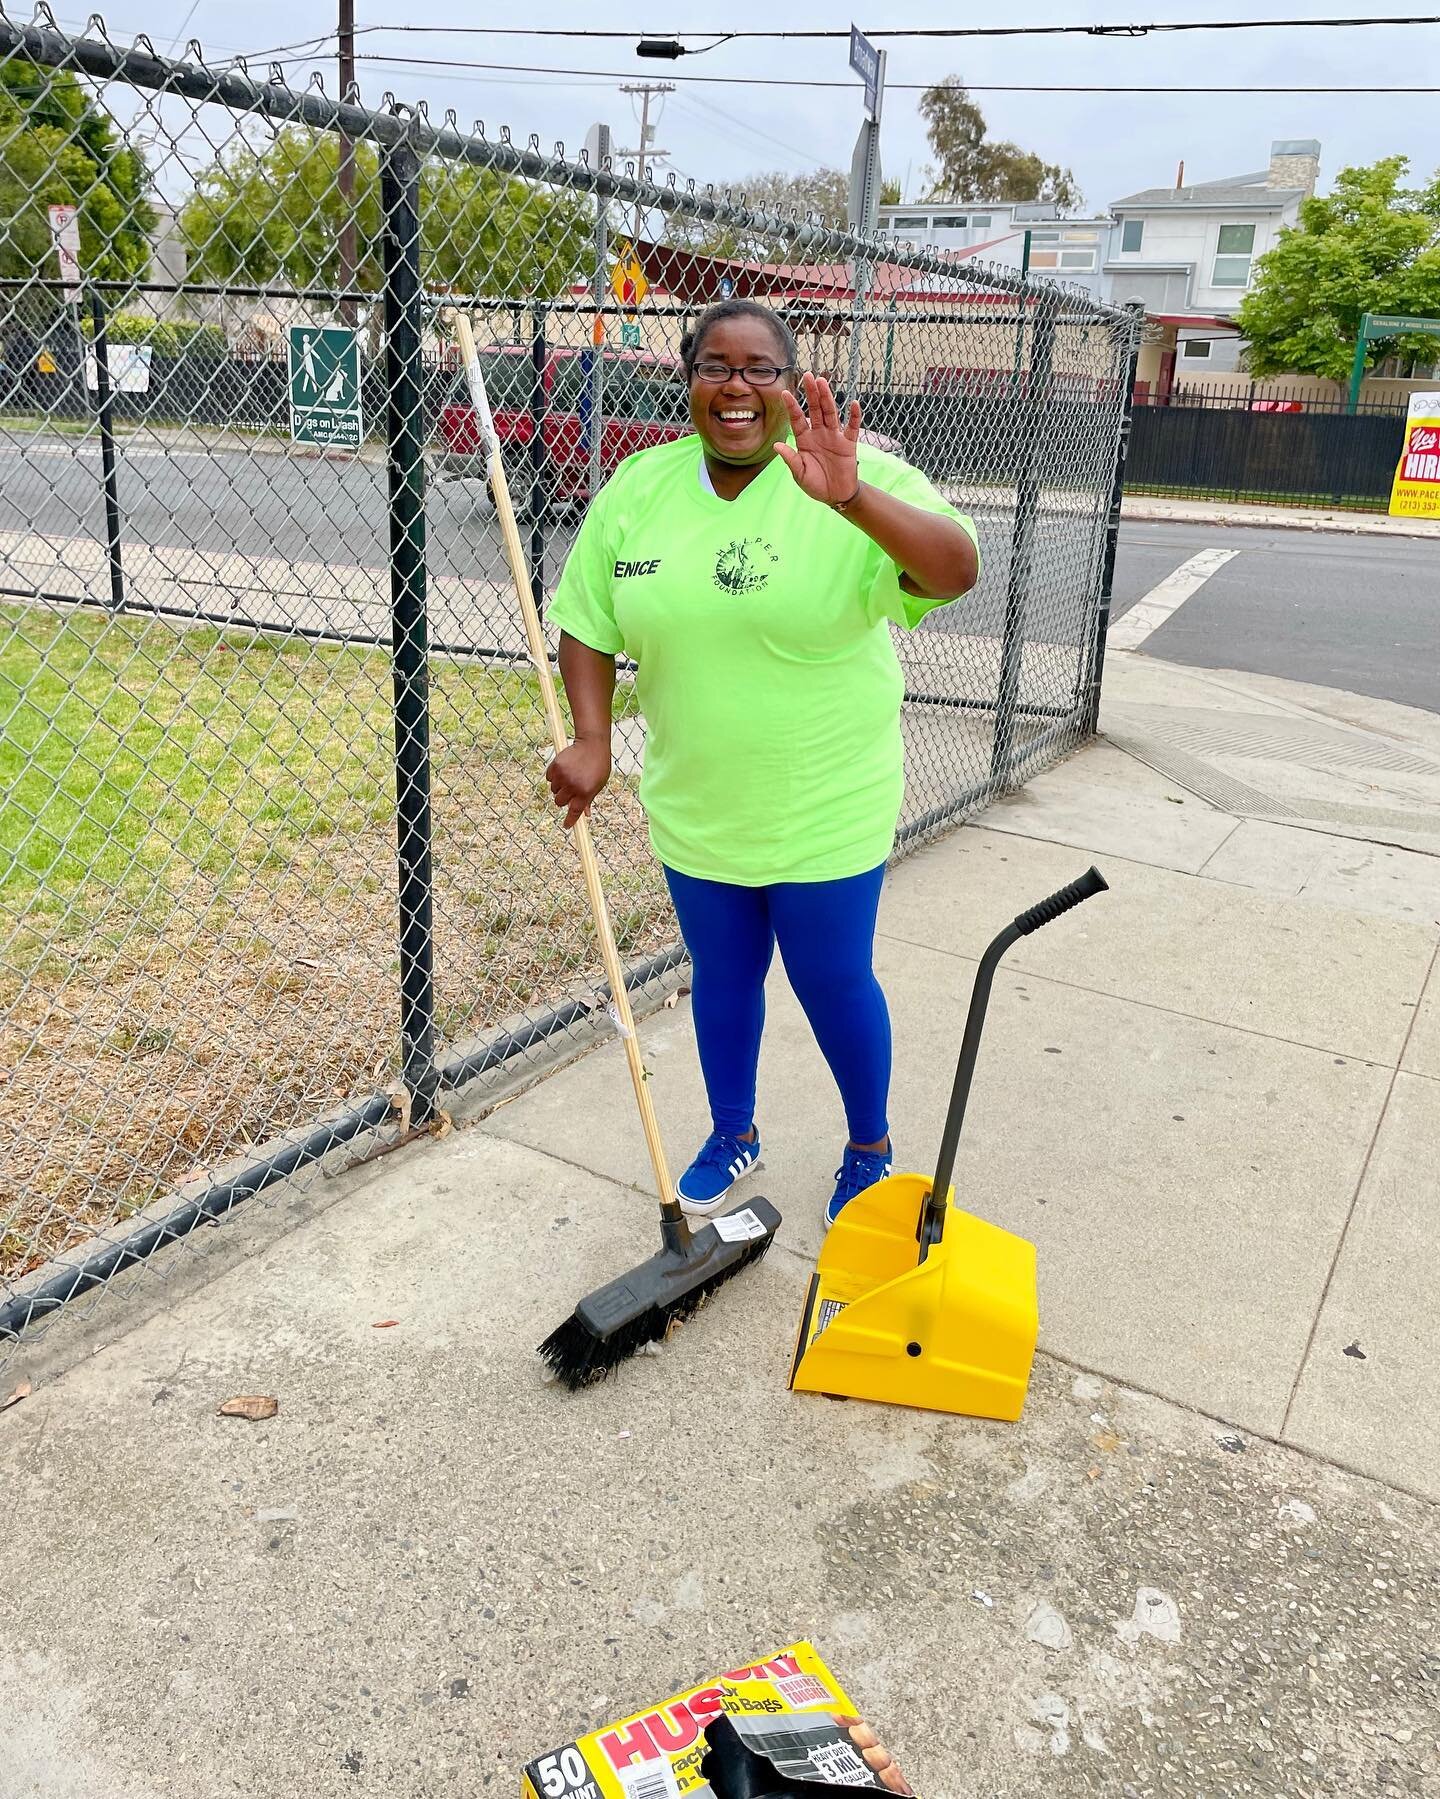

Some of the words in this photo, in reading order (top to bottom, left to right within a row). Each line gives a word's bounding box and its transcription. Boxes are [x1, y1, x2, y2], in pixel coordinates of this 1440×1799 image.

[295, 415, 318, 429] Dgs
[319, 420, 331, 429] on
[332, 418, 358, 430] Lash
[1411, 427, 1437, 452] Yes
[712, 575, 769, 596] FOUNDATION
[740, 1698, 783, 1713] Bags
[786, 1686, 831, 1705] TOUGHER
[811, 1751, 832, 1763] HEAVY
[832, 1745, 851, 1757] DUTY
[537, 1748, 586, 1797] 50
[822, 1762, 837, 1778] 3
[833, 1754, 862, 1774] MIL
